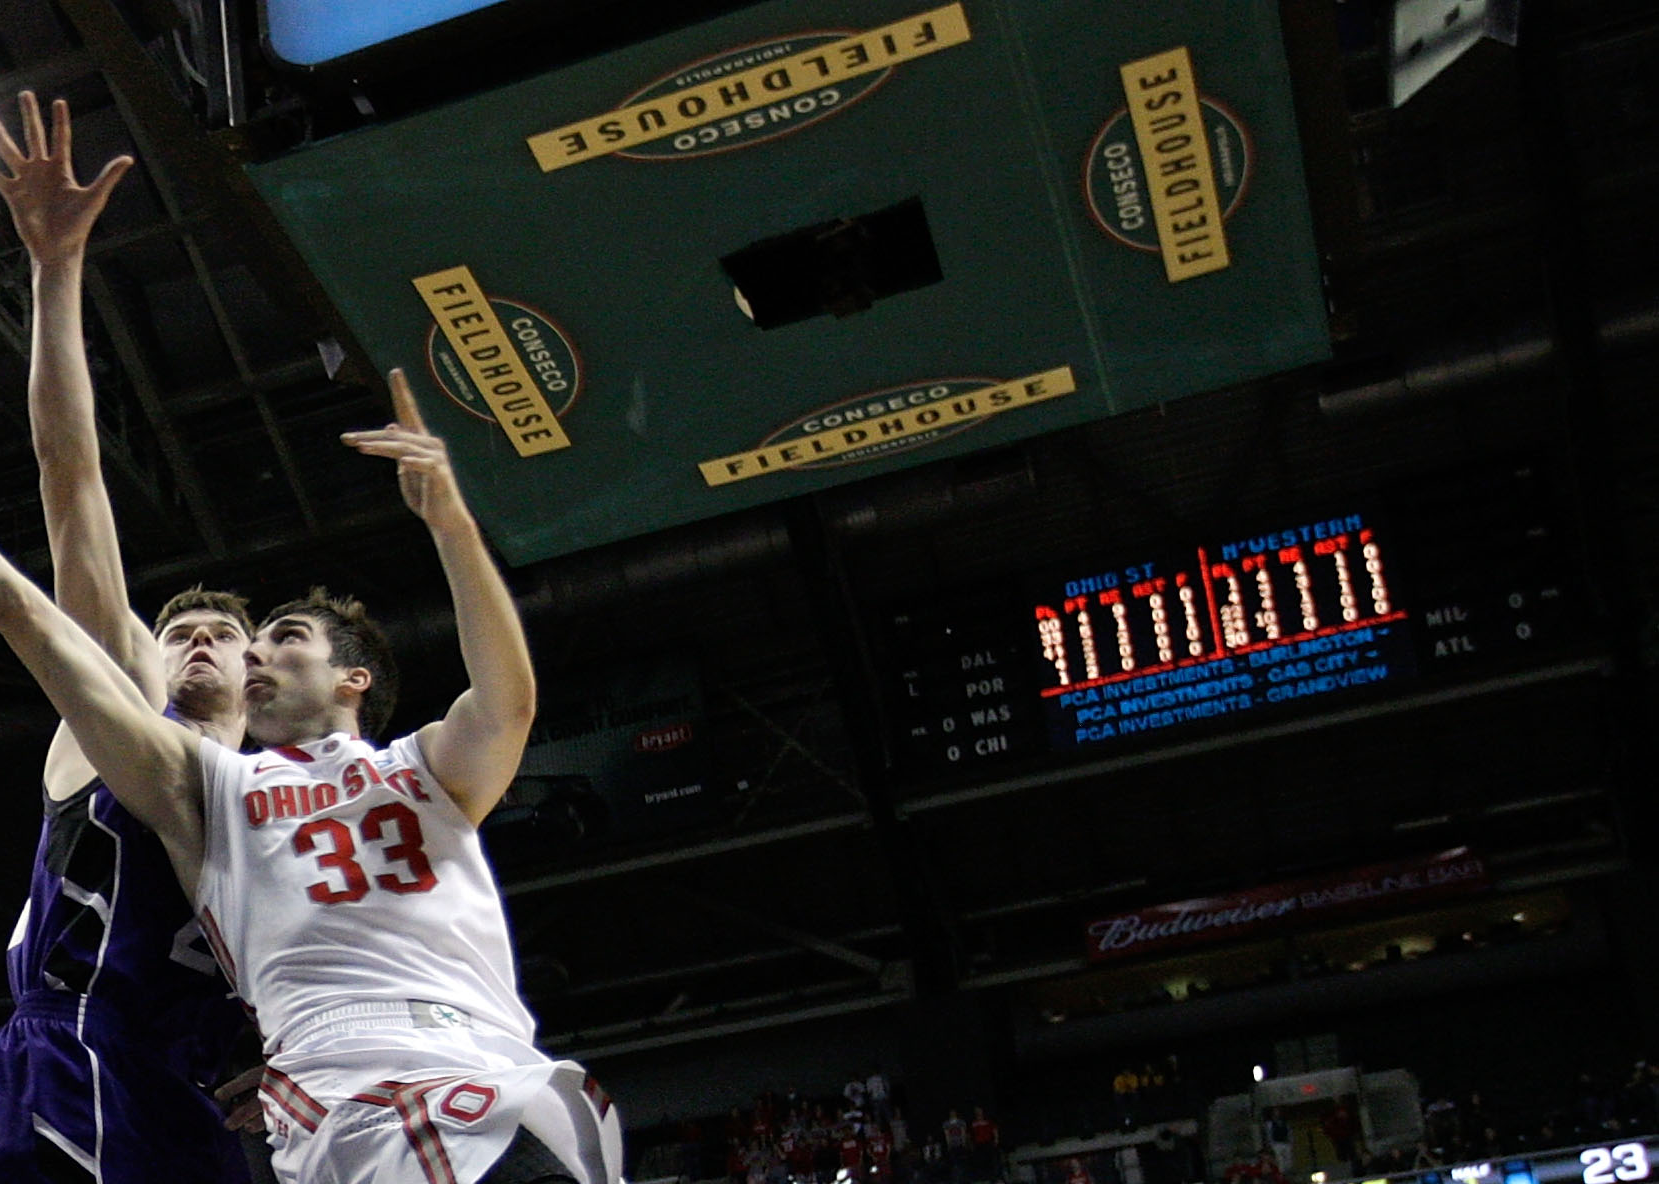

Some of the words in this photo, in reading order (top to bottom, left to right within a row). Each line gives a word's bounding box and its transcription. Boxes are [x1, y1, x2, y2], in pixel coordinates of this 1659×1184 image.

[559, 20, 938, 155] FIELDHOUSE
[674, 89, 840, 151] CONSECO
[1104, 142, 1144, 230] CONSECO
[1139, 67, 1213, 264] FIELDHOUSE
[433, 282, 552, 443] FIELDHOUSE
[511, 317, 568, 391] CONSECO
[725, 378, 1048, 477] FIELDHOUSE
[802, 385, 950, 432] CONSECO
[1065, 571, 1119, 597] OHIO
[1125, 562, 1155, 583] ST
[1425, 604, 1468, 627] MIL
[961, 651, 996, 671] DAL
[1060, 687, 1099, 708] PCA
[1103, 658, 1235, 696] INVESTMENTS
[1249, 628, 1373, 668] BURLINGTON
[1435, 635, 1476, 657] ATL
[966, 677, 1004, 698] POR
[1076, 704, 1118, 724] PCA
[1120, 673, 1253, 714] INVESTMENTS
[1076, 725, 1115, 744] PCA
[1119, 694, 1251, 735] INVESTMENTS
[1267, 663, 1388, 702] GRANDVIEW
[970, 704, 1012, 727] WAS
[974, 734, 1008, 756] CHI
[245, 783, 337, 829] OHIO
[292, 801, 439, 905] 33
[1088, 897, 1303, 951] Budweiser
